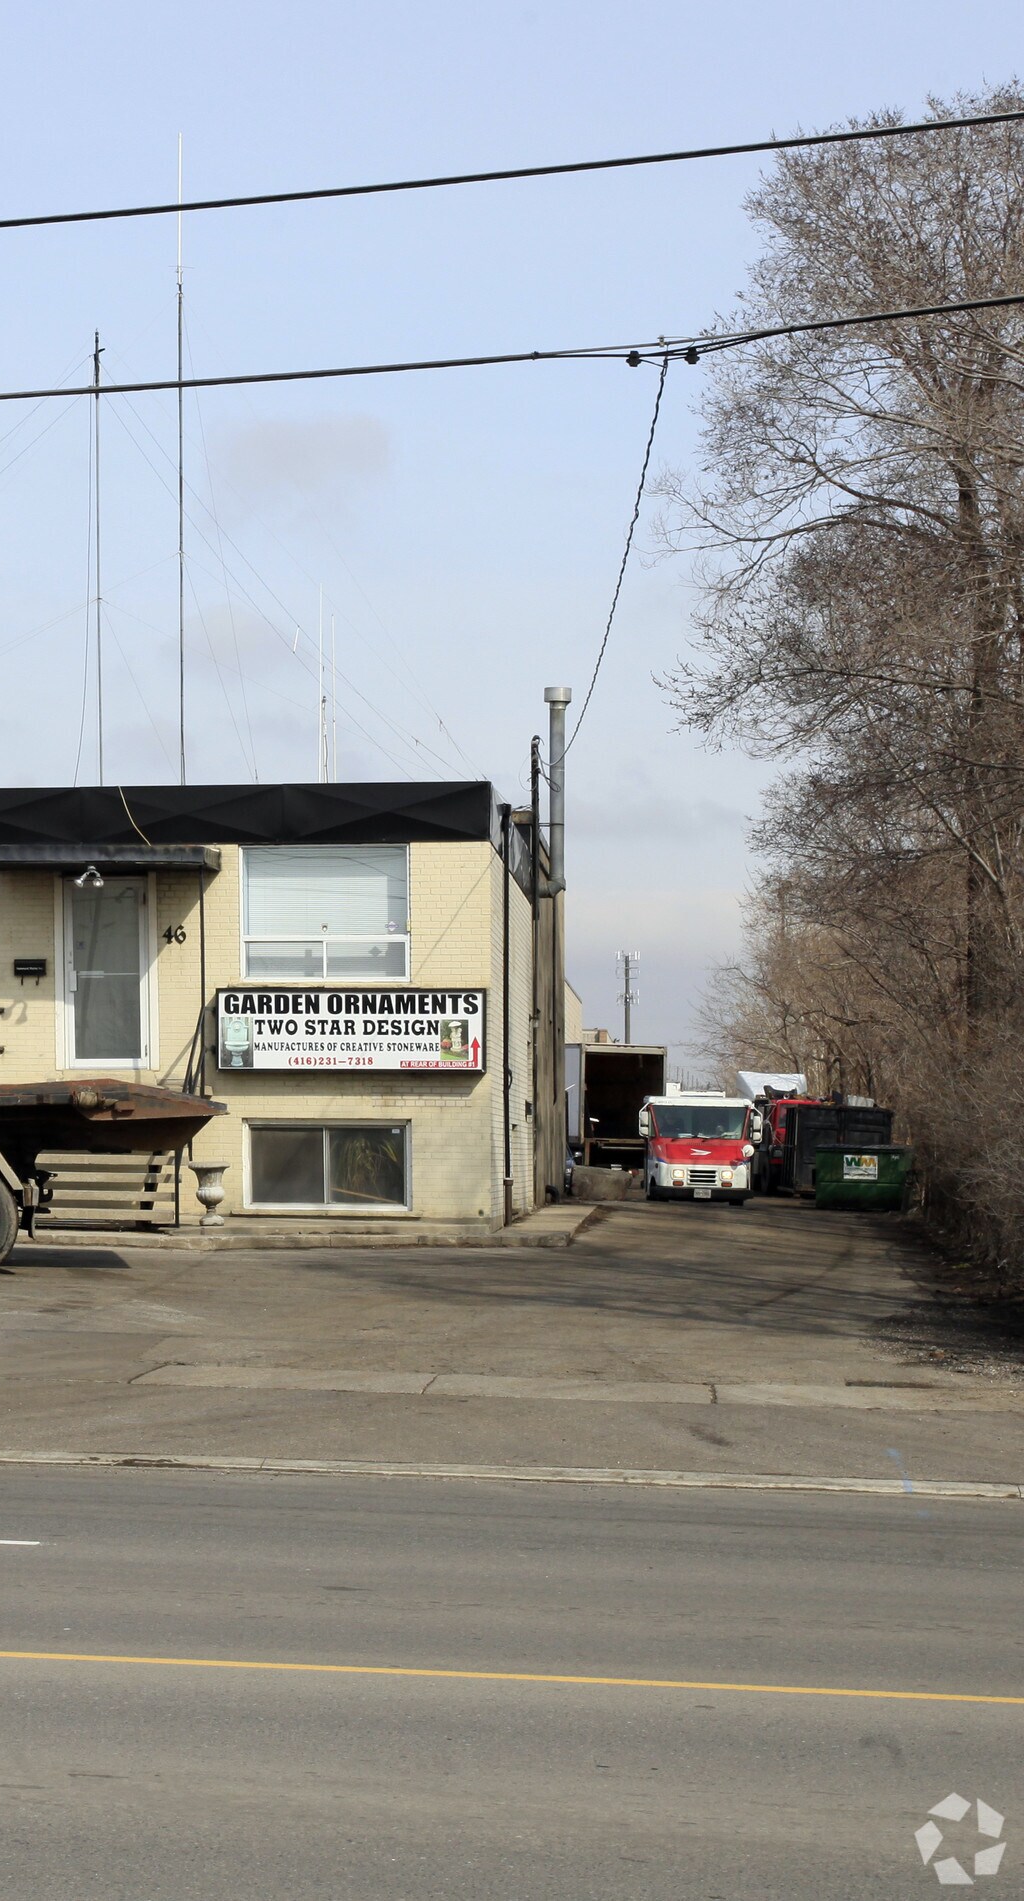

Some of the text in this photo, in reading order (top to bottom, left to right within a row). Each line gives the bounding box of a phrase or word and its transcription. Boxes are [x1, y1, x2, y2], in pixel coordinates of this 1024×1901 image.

[162, 924, 187, 945] 46
[224, 993, 479, 1015] GARDEN ORNAMENTS
[255, 1019, 440, 1036] TWO STAR DESIGN
[254, 1042, 441, 1052] MANUFACTURES OF CREATIVE STONEWARE
